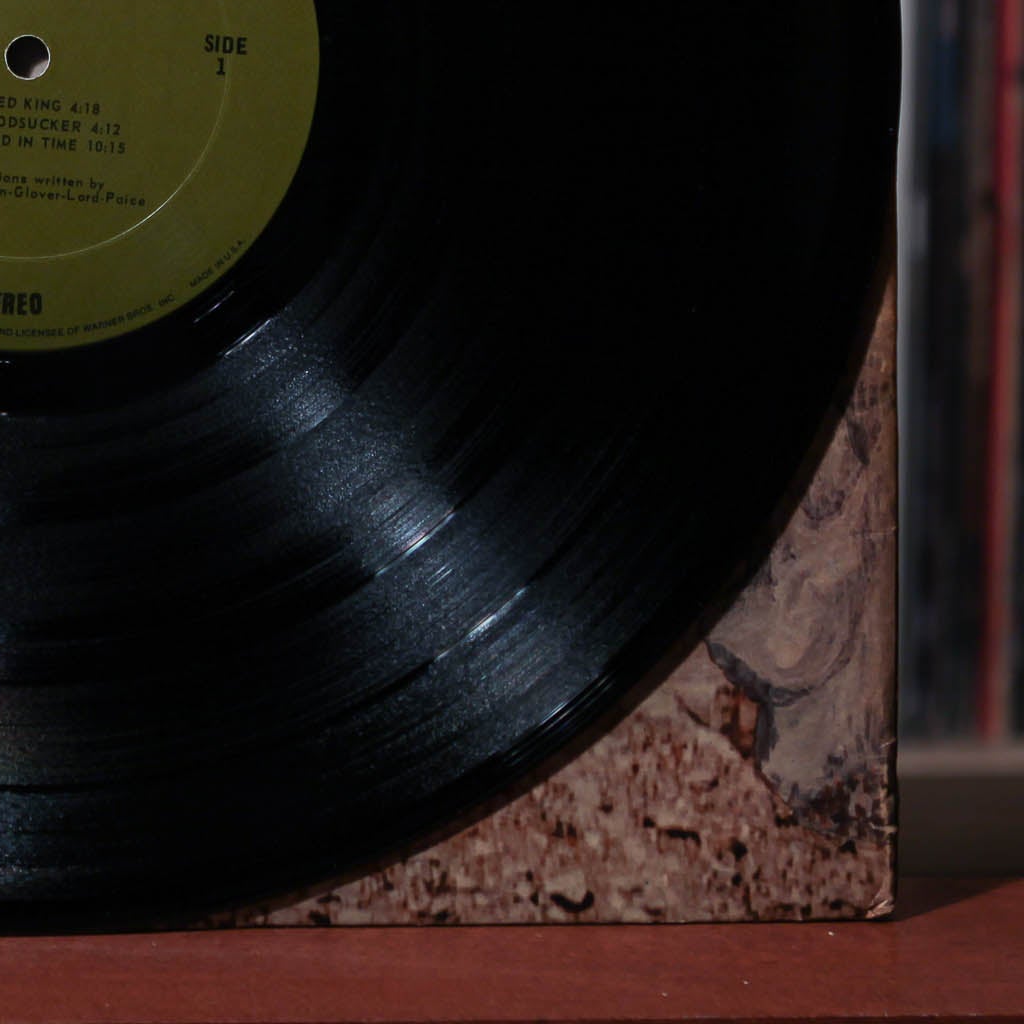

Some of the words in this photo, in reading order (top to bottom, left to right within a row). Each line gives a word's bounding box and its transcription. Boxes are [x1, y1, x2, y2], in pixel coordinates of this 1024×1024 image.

[204, 33, 248, 55] SIDE
[216, 57, 225, 76] 1
[23, 97, 62, 112] KING
[70, 102, 101, 116] 4:18
[90, 122, 121, 136] 4:12
[18, 135, 33, 148] IN
[41, 137, 77, 152] TIME
[87, 139, 126, 155] 10:15
[33, 175, 84, 189] written
[89, 178, 105, 192] by
